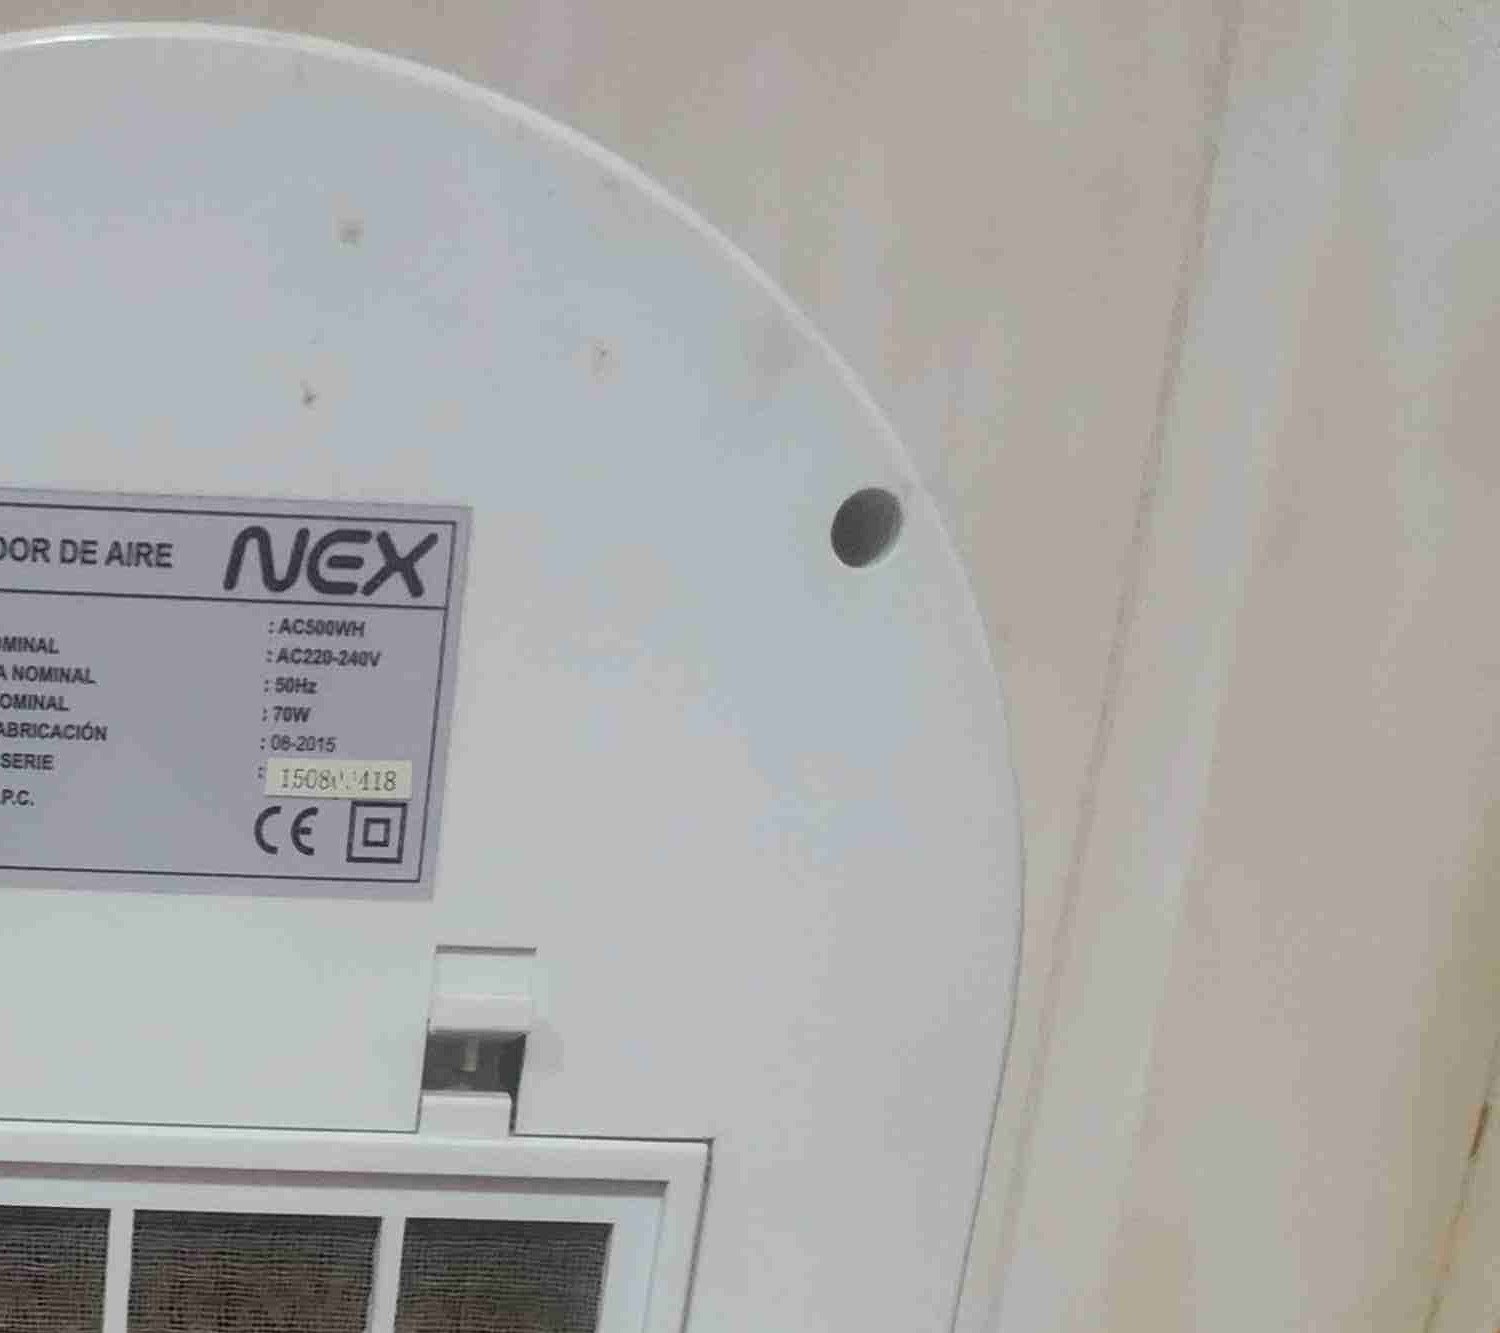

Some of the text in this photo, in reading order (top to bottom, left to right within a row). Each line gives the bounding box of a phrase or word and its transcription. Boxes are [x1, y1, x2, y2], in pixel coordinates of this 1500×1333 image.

[59, 538, 99, 566] DE
[104, 540, 174, 568] AIRE
[223, 525, 439, 598] NEX
[277, 618, 366, 638] AC500WH
[276, 648, 384, 668] AC220-240V
[11, 665, 97, 684] NOMINAL
[274, 677, 318, 695] 50Hz
[272, 706, 312, 723] 70W
[0, 752, 55, 771] SERIE
[254, 805, 319, 856] CE
